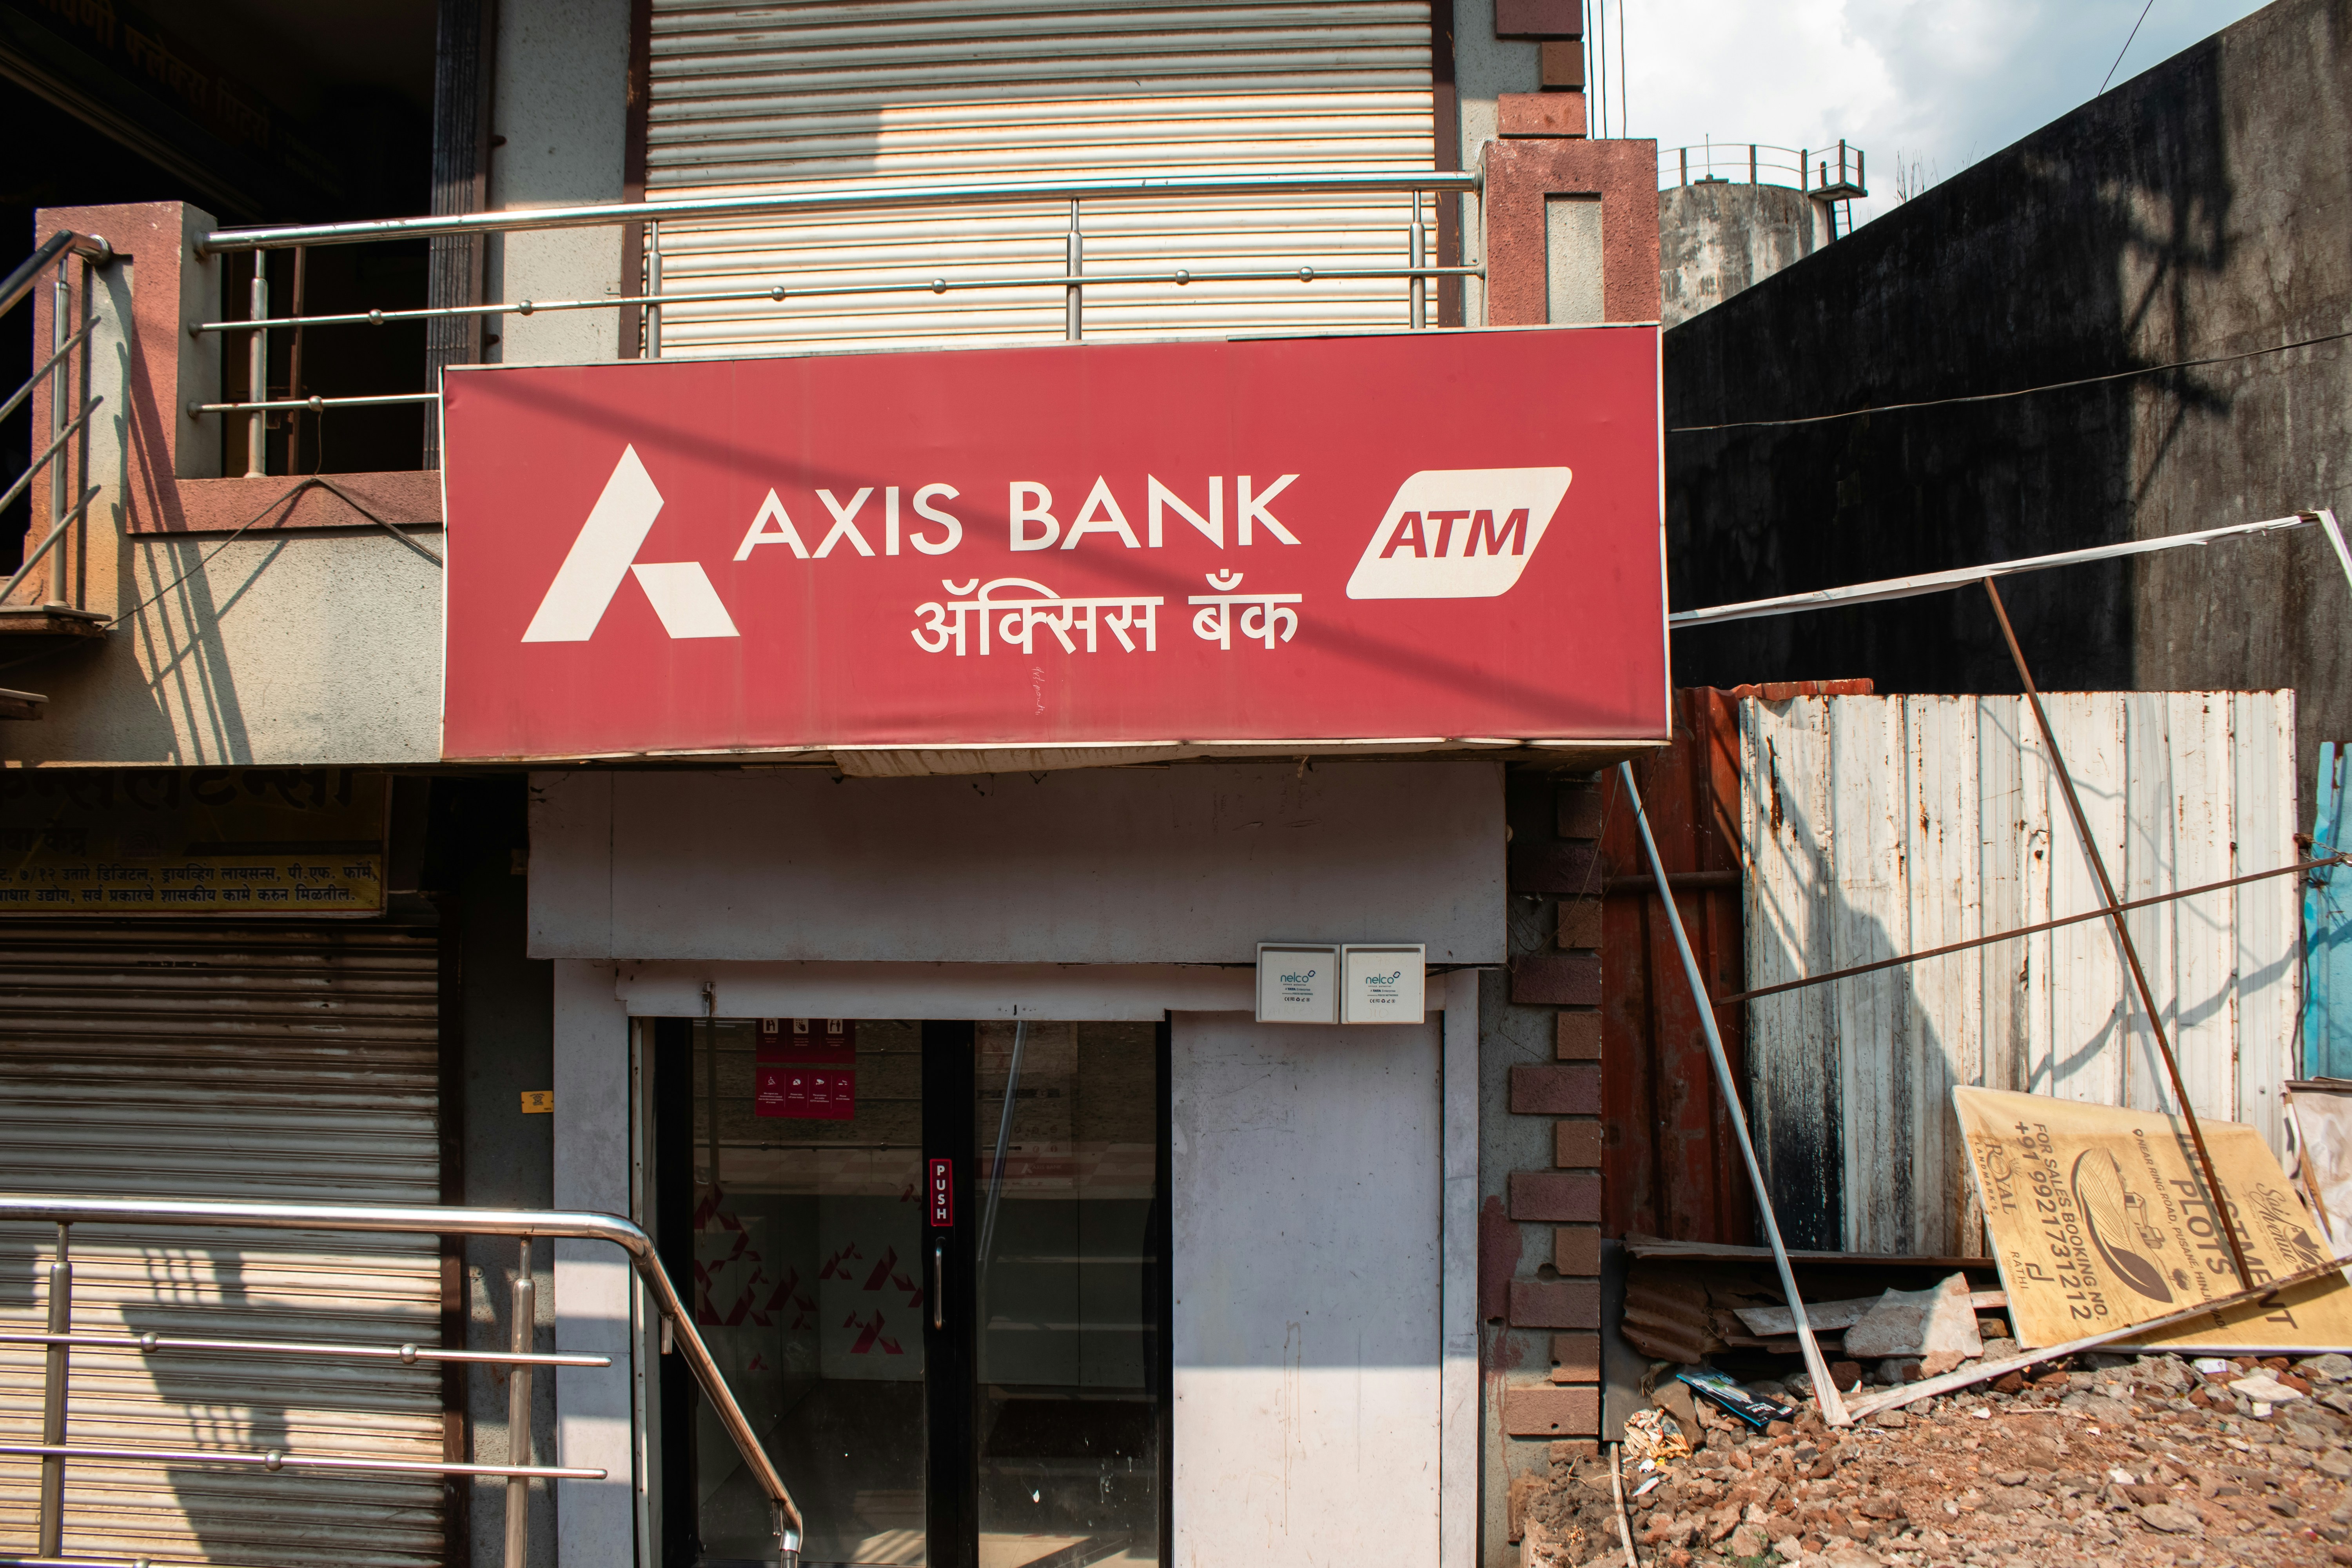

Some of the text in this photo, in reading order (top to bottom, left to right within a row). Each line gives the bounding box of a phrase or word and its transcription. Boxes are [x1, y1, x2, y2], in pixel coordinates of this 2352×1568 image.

[733, 473, 1302, 561] AXIS BANK
[1379, 508, 1530, 558] ATM
[35, 884, 75, 904] उद्योग,
[81, 884, 103, 902] सर्व
[108, 884, 154, 902] प्रकारचे
[160, 884, 217, 902] शासकीय
[222, 884, 251, 901] कामे
[294, 883, 356, 901] मिळतील.
[62, 864, 91, 881] उतारे
[97, 864, 154, 883] डिजिटल,
[160, 863, 216, 884] ड्रायव्हिंग
[220, 867, 281, 883] लायसन्स,
[1280, 972, 1309, 983] nelco
[1366, 973, 1394, 984] nelco
[936, 1165, 946, 1219] PUSH
[1984, 1143, 2018, 1215] ROYAL
[2136, 1138, 2154, 1165] NEAR
[2148, 1167, 2165, 1191] RING
[2160, 1193, 2177, 1224] ROAD,
[2172, 1227, 2200, 1269] PUSANE,
[2014, 1122, 2092, 1320] +91 9921731212
[2033, 1123, 2108, 1320] FOR SALES BOOKING NO.
[2169, 1180, 2235, 1274] PLOTS
[2010, 1251, 2030, 1289] RATHI
